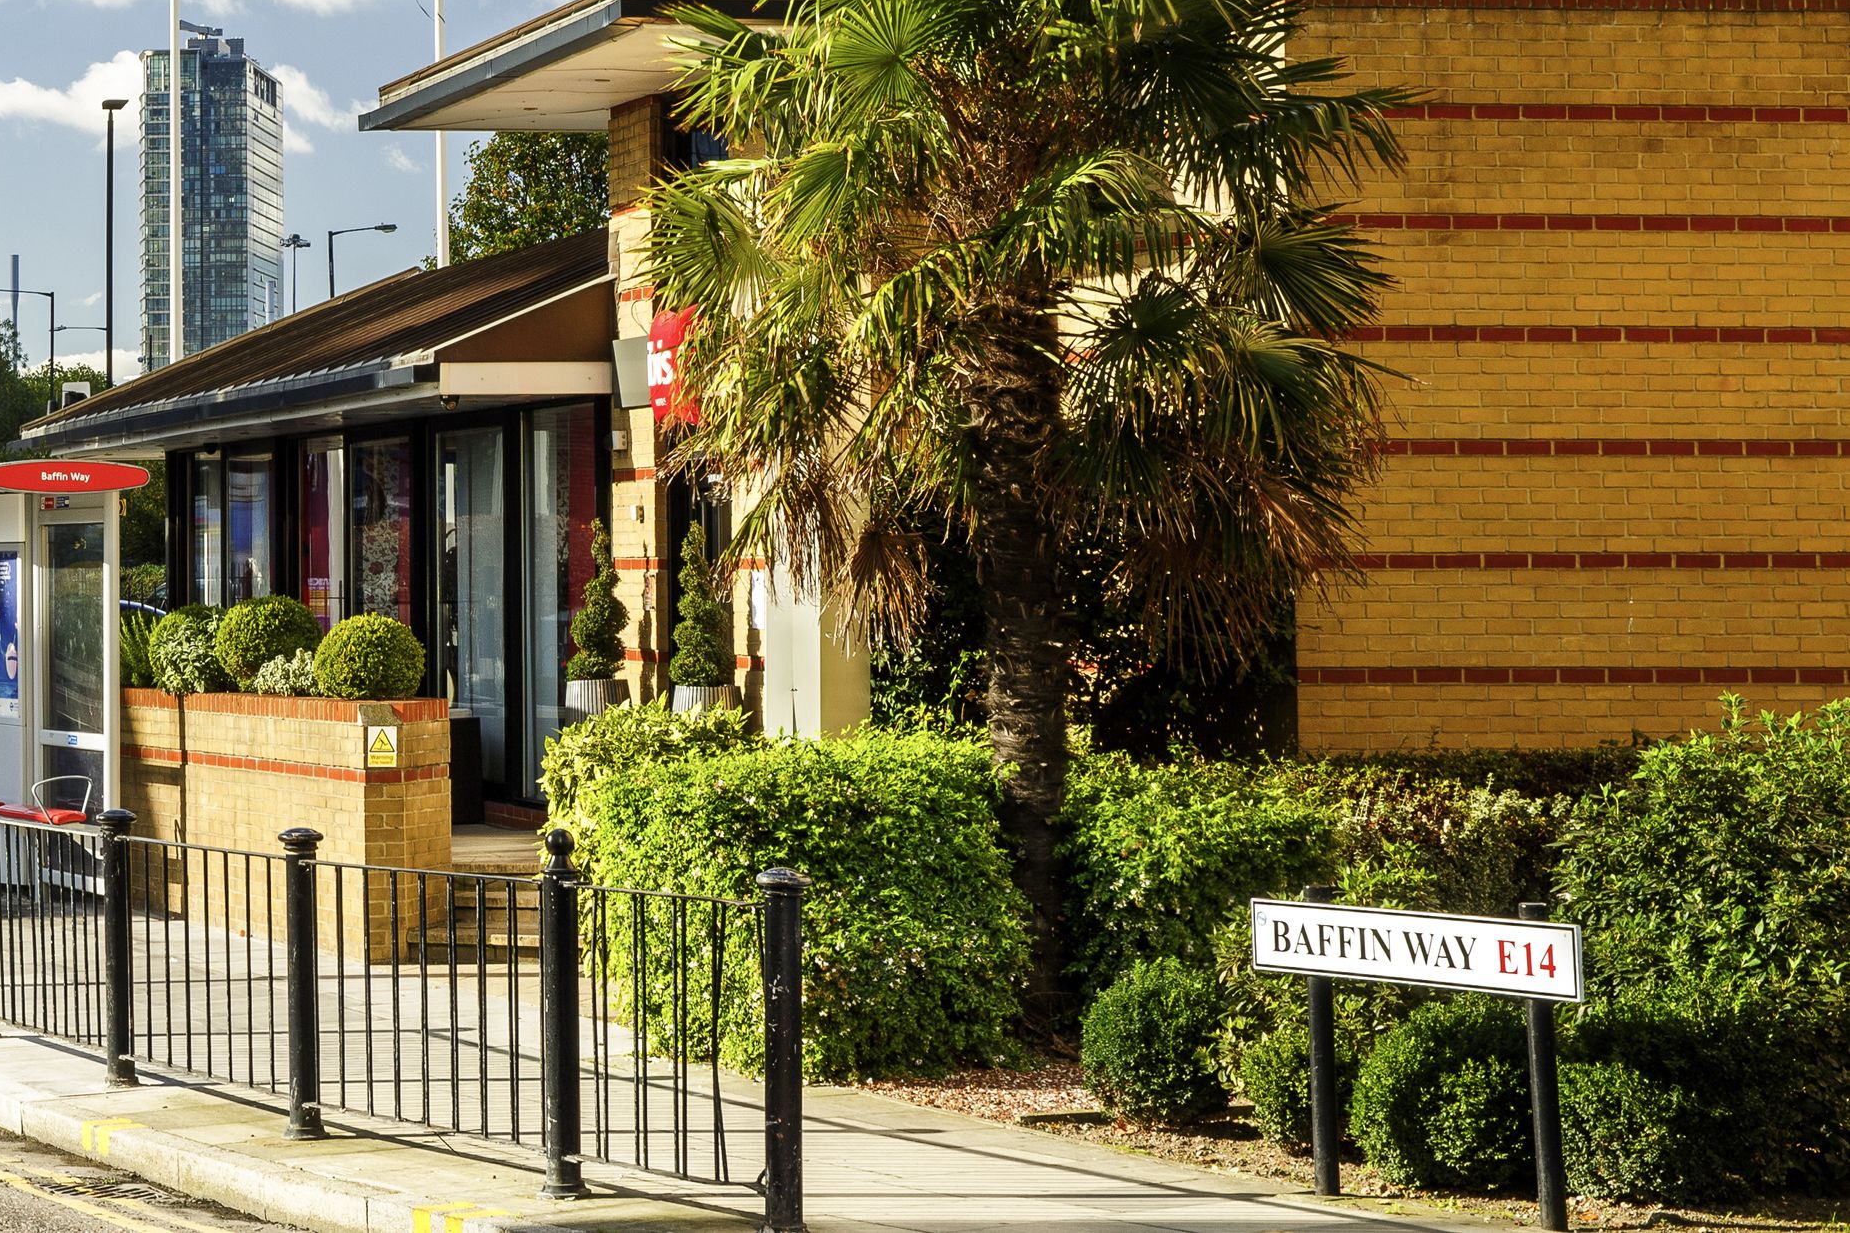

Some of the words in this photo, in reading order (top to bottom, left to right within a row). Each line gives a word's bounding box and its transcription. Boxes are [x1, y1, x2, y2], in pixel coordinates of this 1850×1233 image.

[41, 471, 68, 481] Baffin
[70, 472, 90, 483] Way
[1272, 919, 1392, 963] BAFFIN
[1402, 930, 1477, 971] WAY
[1496, 938, 1557, 979] E14
